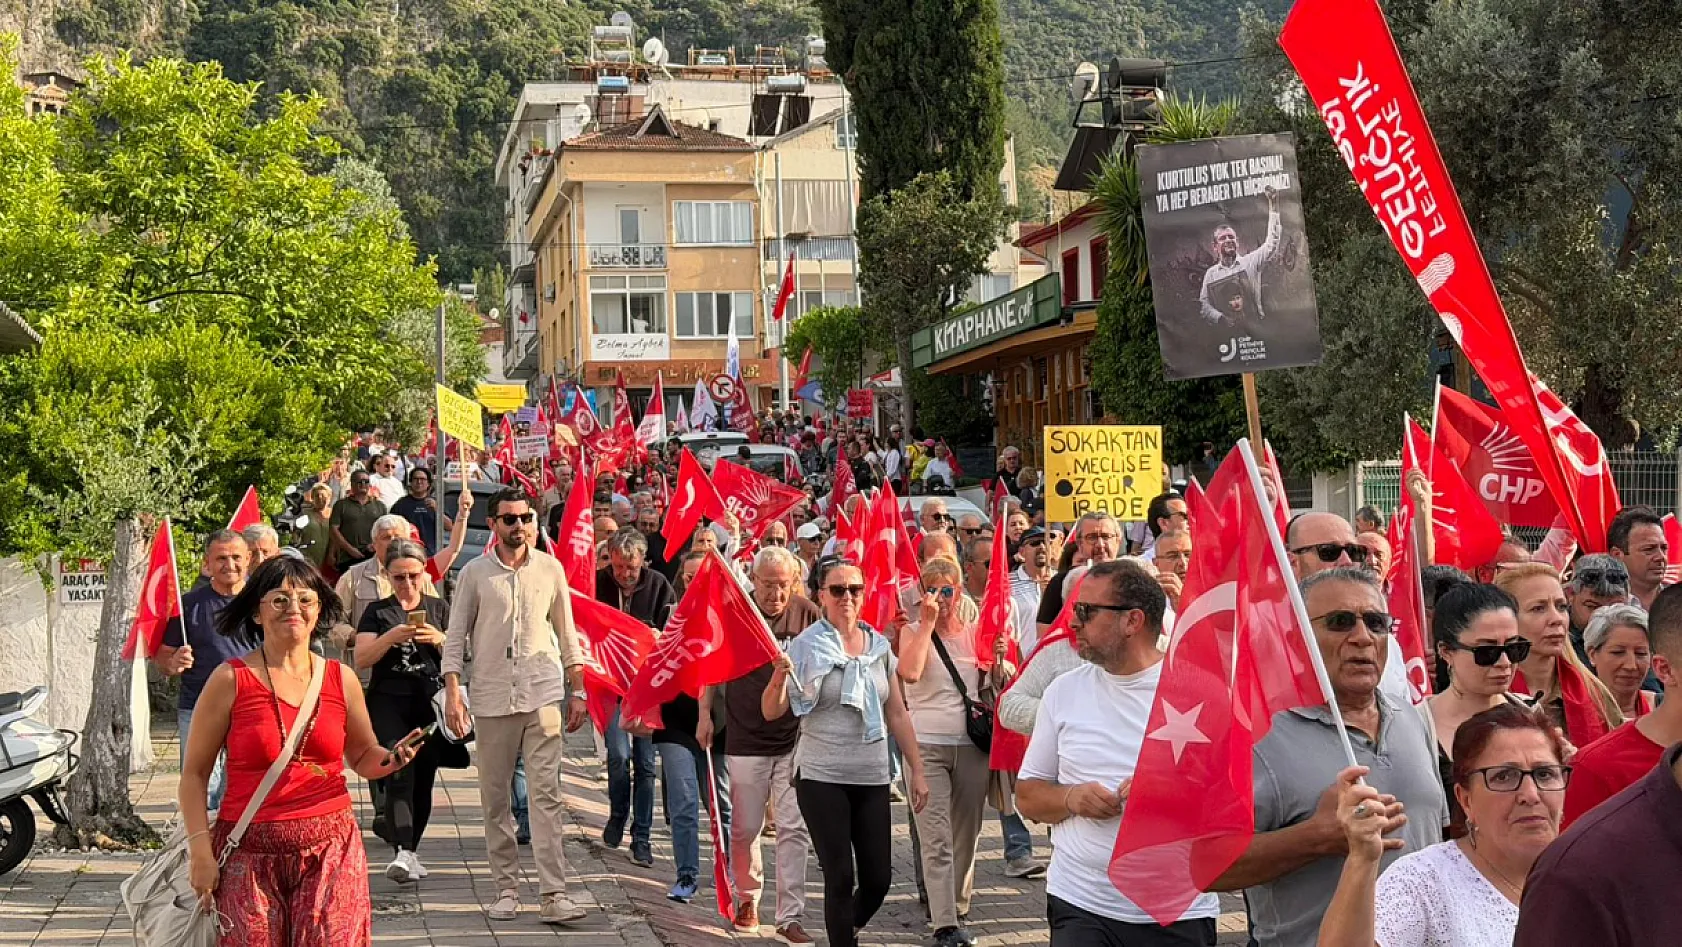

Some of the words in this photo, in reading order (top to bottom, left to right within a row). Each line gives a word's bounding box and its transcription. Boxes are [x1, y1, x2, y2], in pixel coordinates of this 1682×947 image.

[1157, 164, 1209, 191] KURTULUŞ
[1209, 162, 1230, 182] YOK
[1229, 159, 1248, 179] TEK
[1155, 194, 1169, 214] YA
[1170, 190, 1189, 211] HEP
[1189, 183, 1231, 207] BERABER
[1230, 180, 1243, 199] YA
[1050, 430, 1158, 454] SOKAKTAN
[1055, 471, 1136, 497] ÖZGÜR
[1479, 472, 1545, 505] CHP
[1072, 497, 1143, 518] İRADE
[568, 507, 595, 556] CHP
[62, 575, 90, 588] ARAÇ
[92, 575, 105, 586] PA
